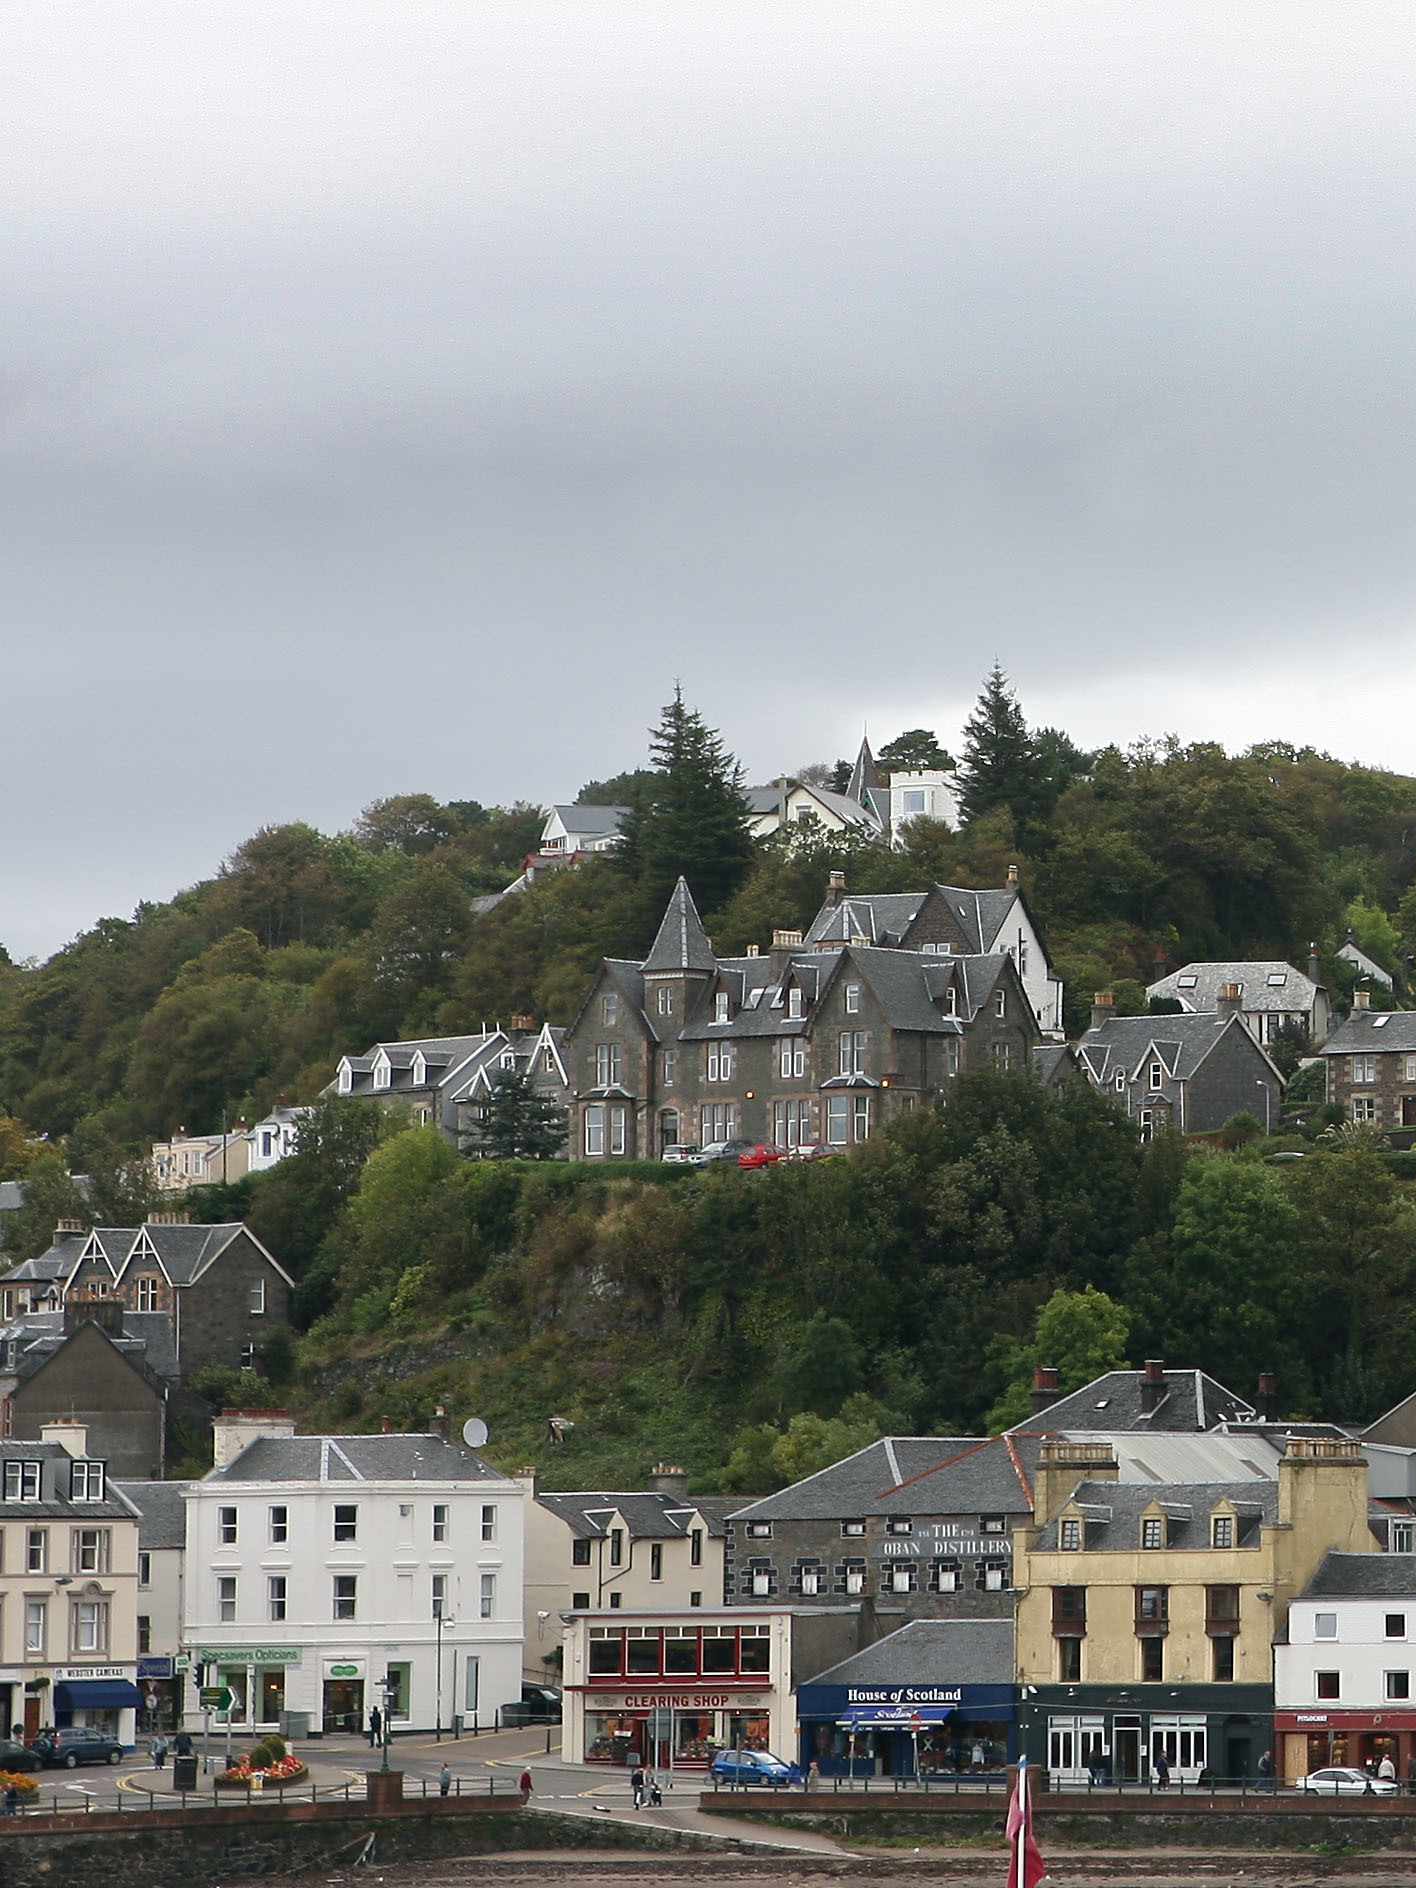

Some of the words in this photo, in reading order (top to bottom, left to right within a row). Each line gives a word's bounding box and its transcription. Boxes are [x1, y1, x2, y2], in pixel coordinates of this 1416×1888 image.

[932, 1524, 959, 1537] THE
[884, 1542, 920, 1555] OBAN
[934, 1540, 1012, 1554] DISTILLERY
[201, 1648, 255, 1662] Specsavers
[255, 1648, 298, 1662] Opticians
[67, 1667, 95, 1678] WEBSTER
[96, 1667, 124, 1678] CAMERAS
[624, 1695, 690, 1708] CLEARING
[693, 1695, 729, 1707] SHOP
[848, 1688, 887, 1701] House
[890, 1688, 904, 1703] of
[906, 1688, 962, 1701] Scotland
